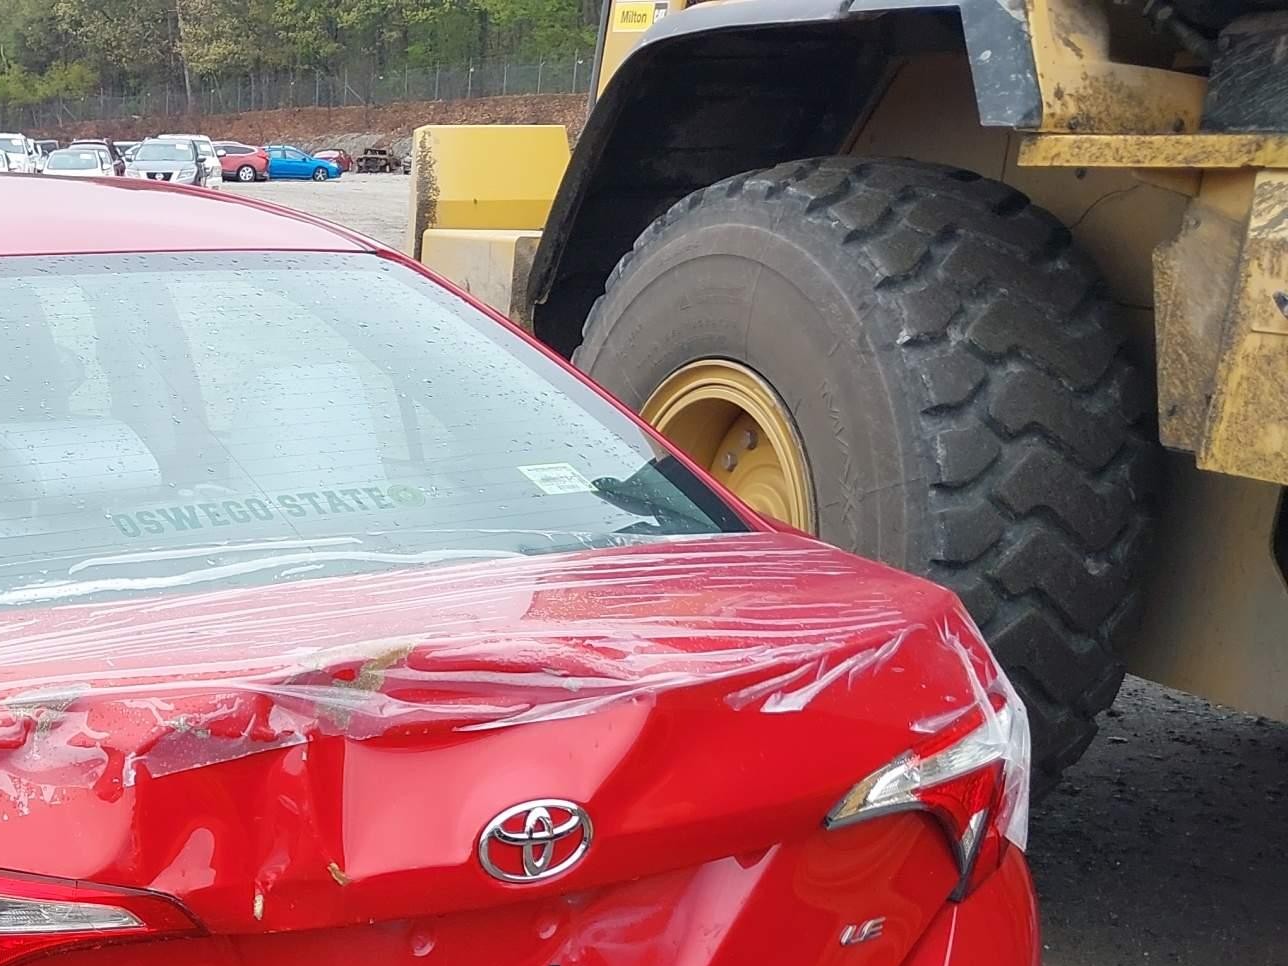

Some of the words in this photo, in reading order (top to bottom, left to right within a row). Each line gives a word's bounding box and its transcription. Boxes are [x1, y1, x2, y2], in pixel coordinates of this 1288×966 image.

[620, 10, 647, 24] Milton
[112, 499, 274, 538] OSWEGO
[277, 487, 393, 516] STATE
[839, 916, 886, 946] LE
